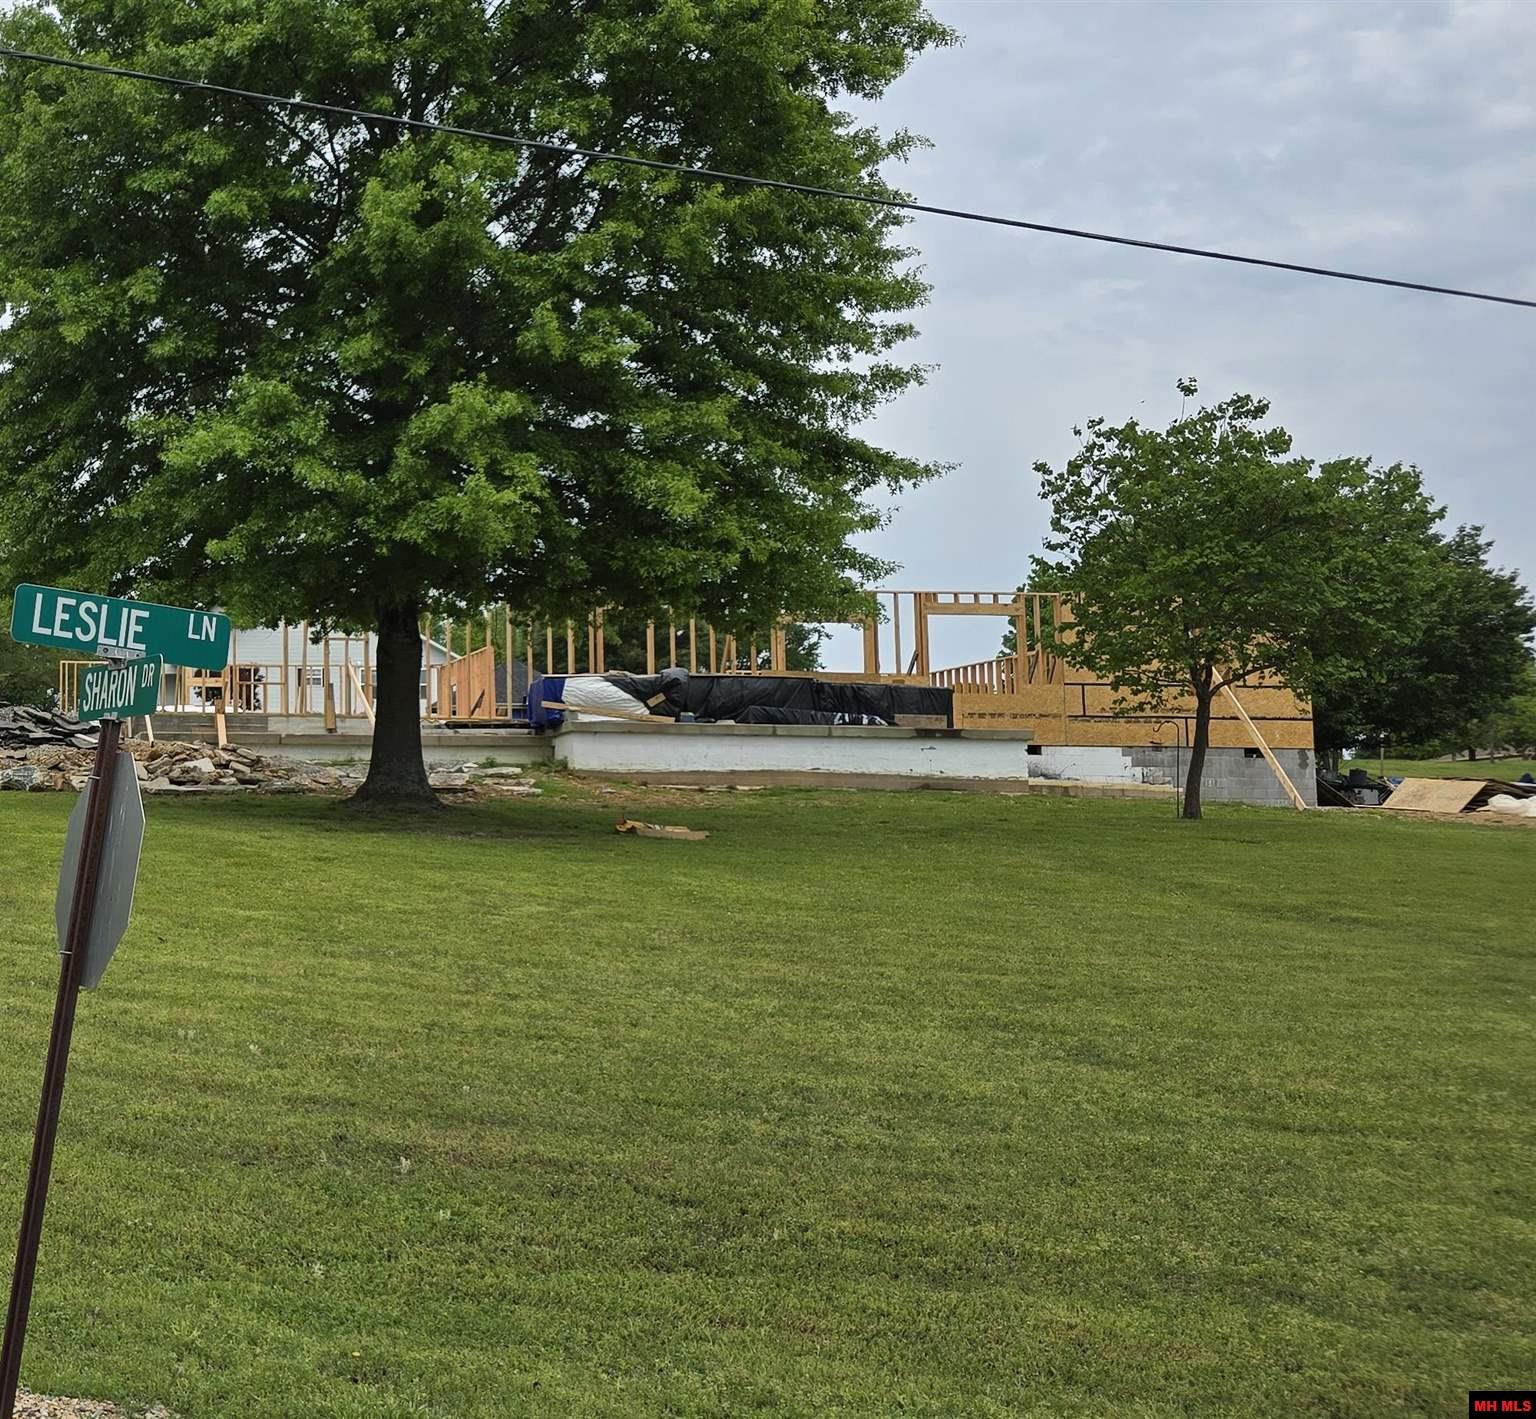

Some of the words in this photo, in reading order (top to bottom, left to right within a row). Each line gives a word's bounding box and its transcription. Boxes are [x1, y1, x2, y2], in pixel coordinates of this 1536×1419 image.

[31, 592, 150, 651] LESLIE
[187, 613, 217, 642] LN
[82, 664, 138, 712] SHARON
[141, 663, 155, 688] DR
